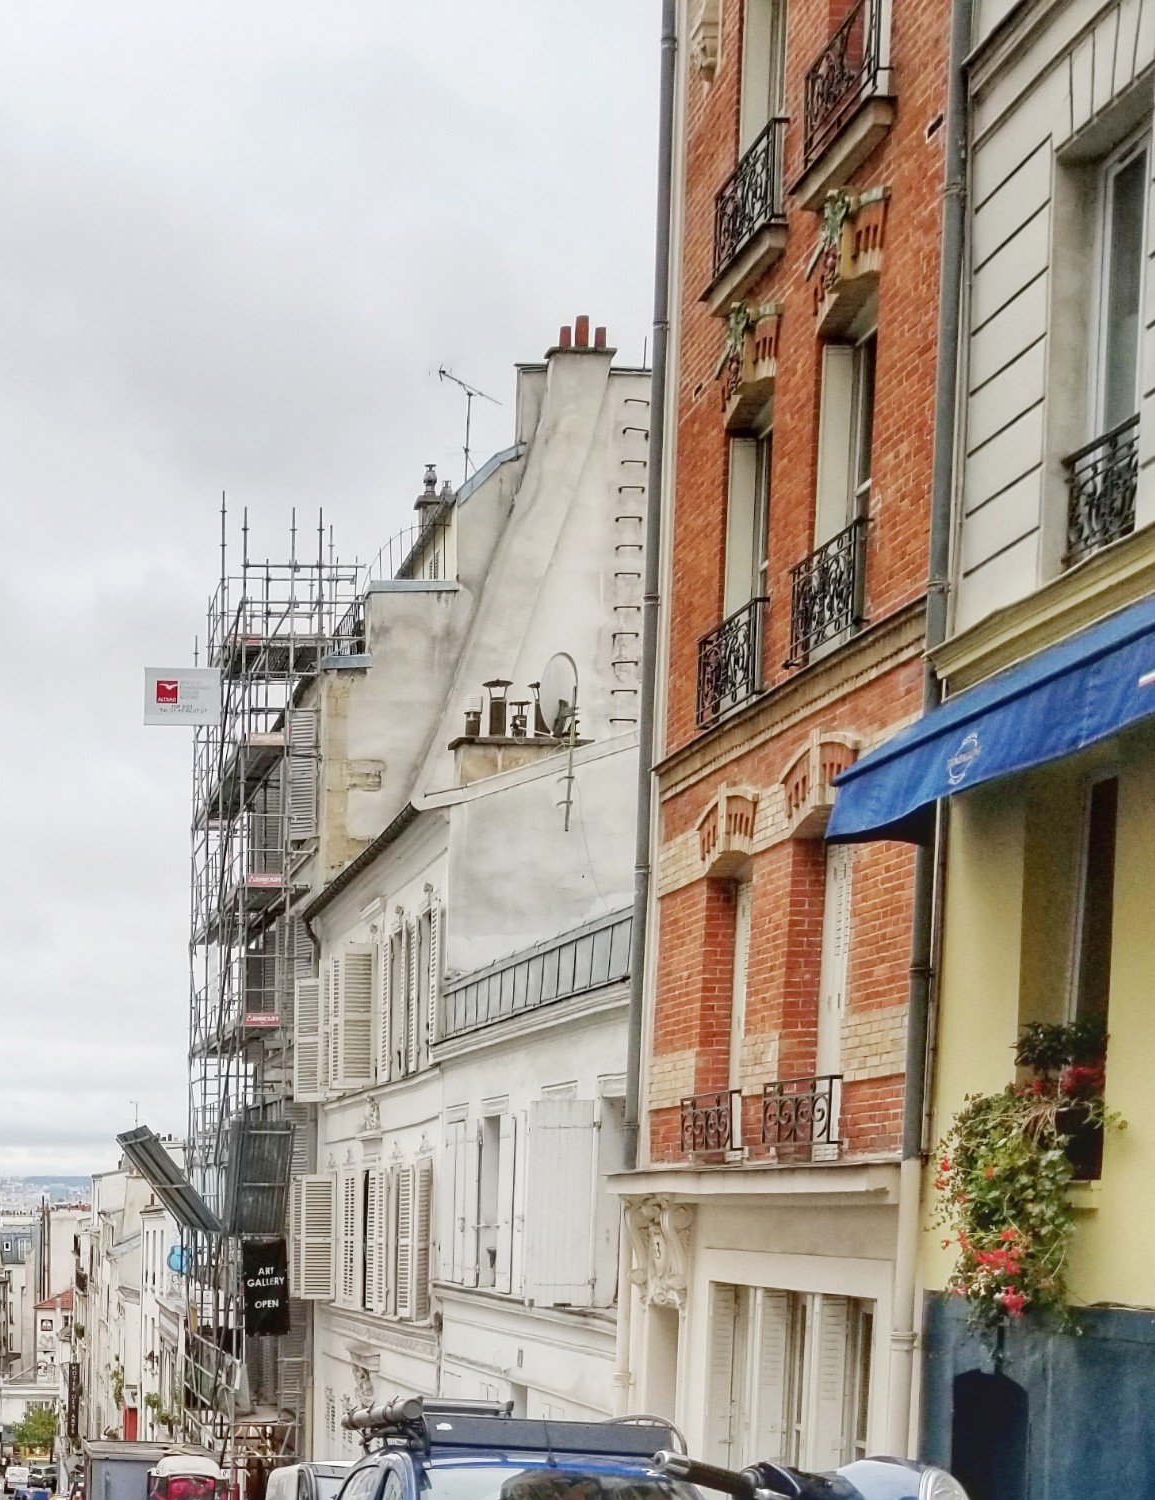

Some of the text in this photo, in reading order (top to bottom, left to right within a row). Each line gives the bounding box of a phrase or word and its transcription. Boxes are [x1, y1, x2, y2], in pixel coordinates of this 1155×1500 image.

[258, 1267, 275, 1276] ART
[247, 1277, 285, 1287] GALLERY
[254, 1300, 279, 1309] OPEN
